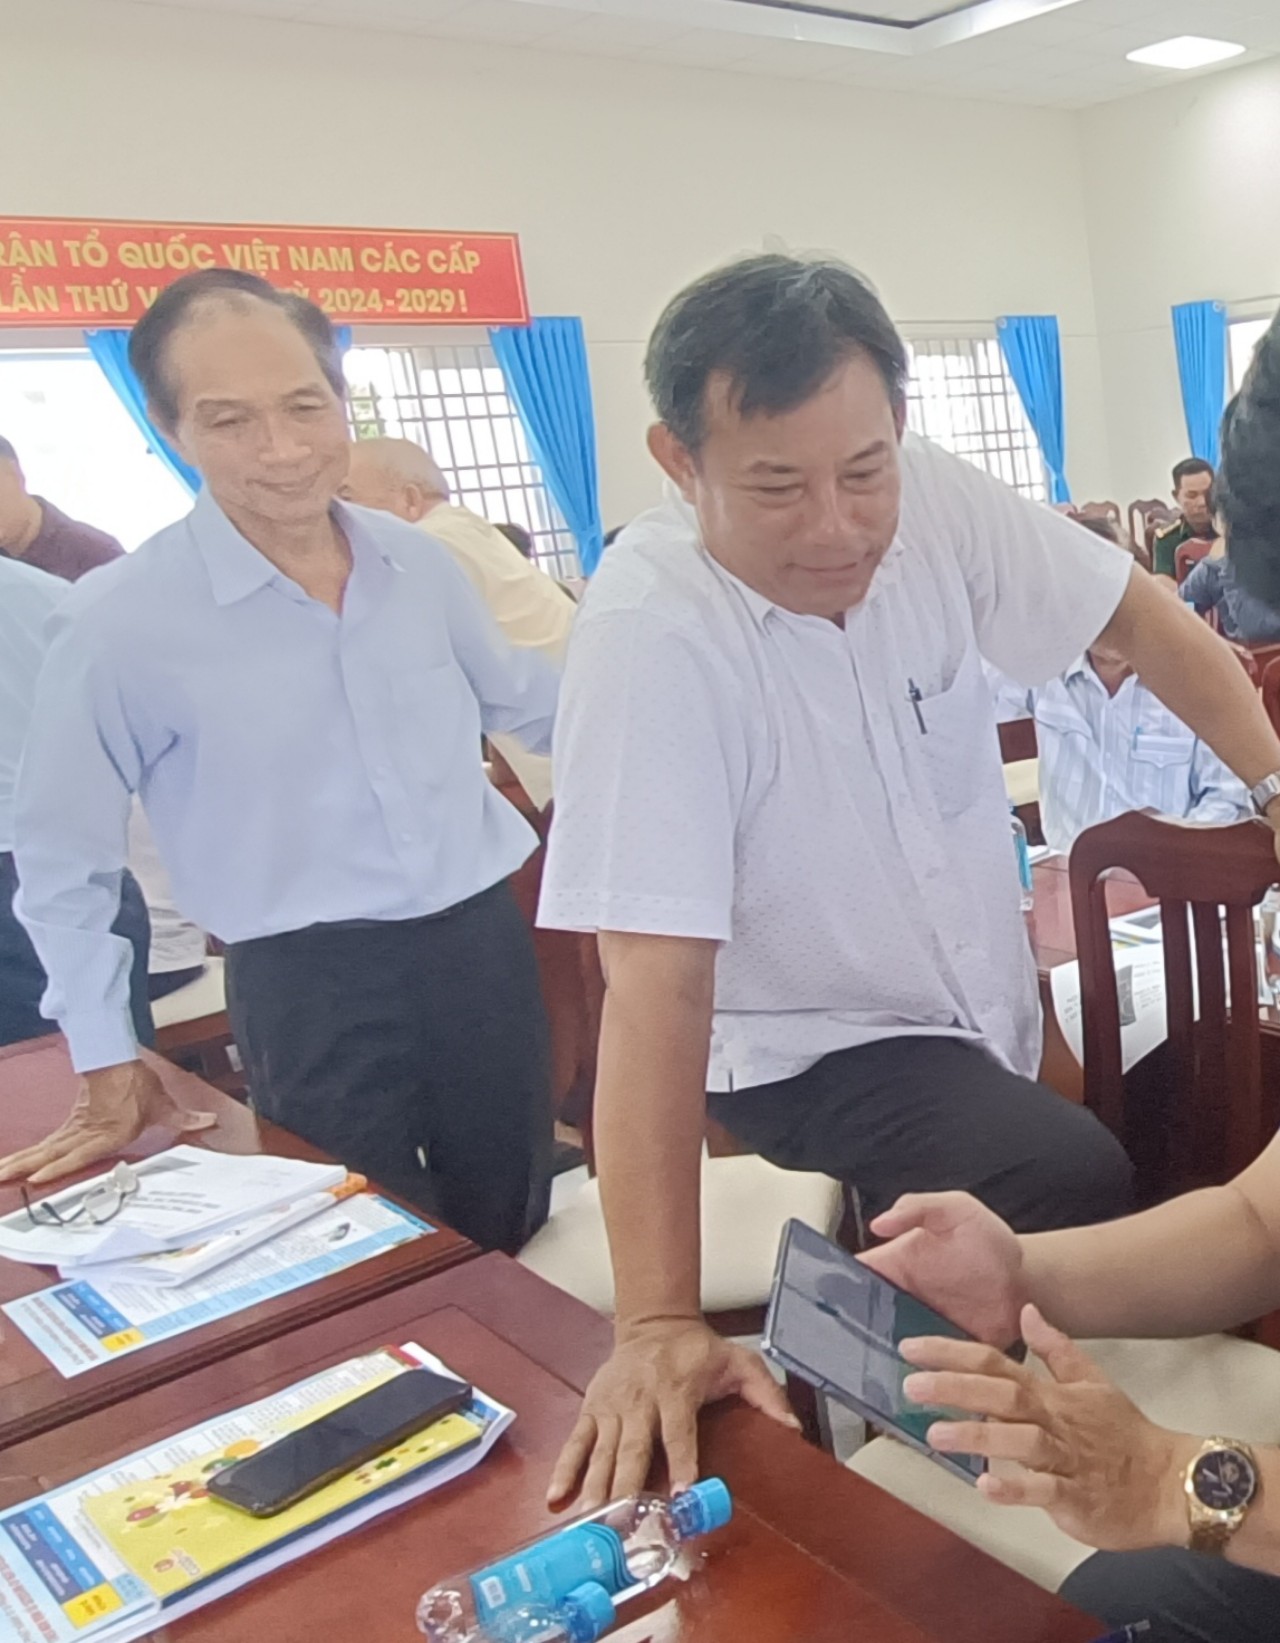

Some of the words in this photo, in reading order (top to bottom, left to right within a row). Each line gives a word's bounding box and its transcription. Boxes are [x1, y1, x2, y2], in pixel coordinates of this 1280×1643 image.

[63, 228, 108, 267] TỔ
[117, 233, 216, 269] QUỐC
[220, 238, 280, 277] VIỆT
[288, 246, 354, 272] NAM
[360, 241, 422, 273] CÁC
[427, 241, 481, 274] CẤP
[65, 278, 129, 312] THỨ
